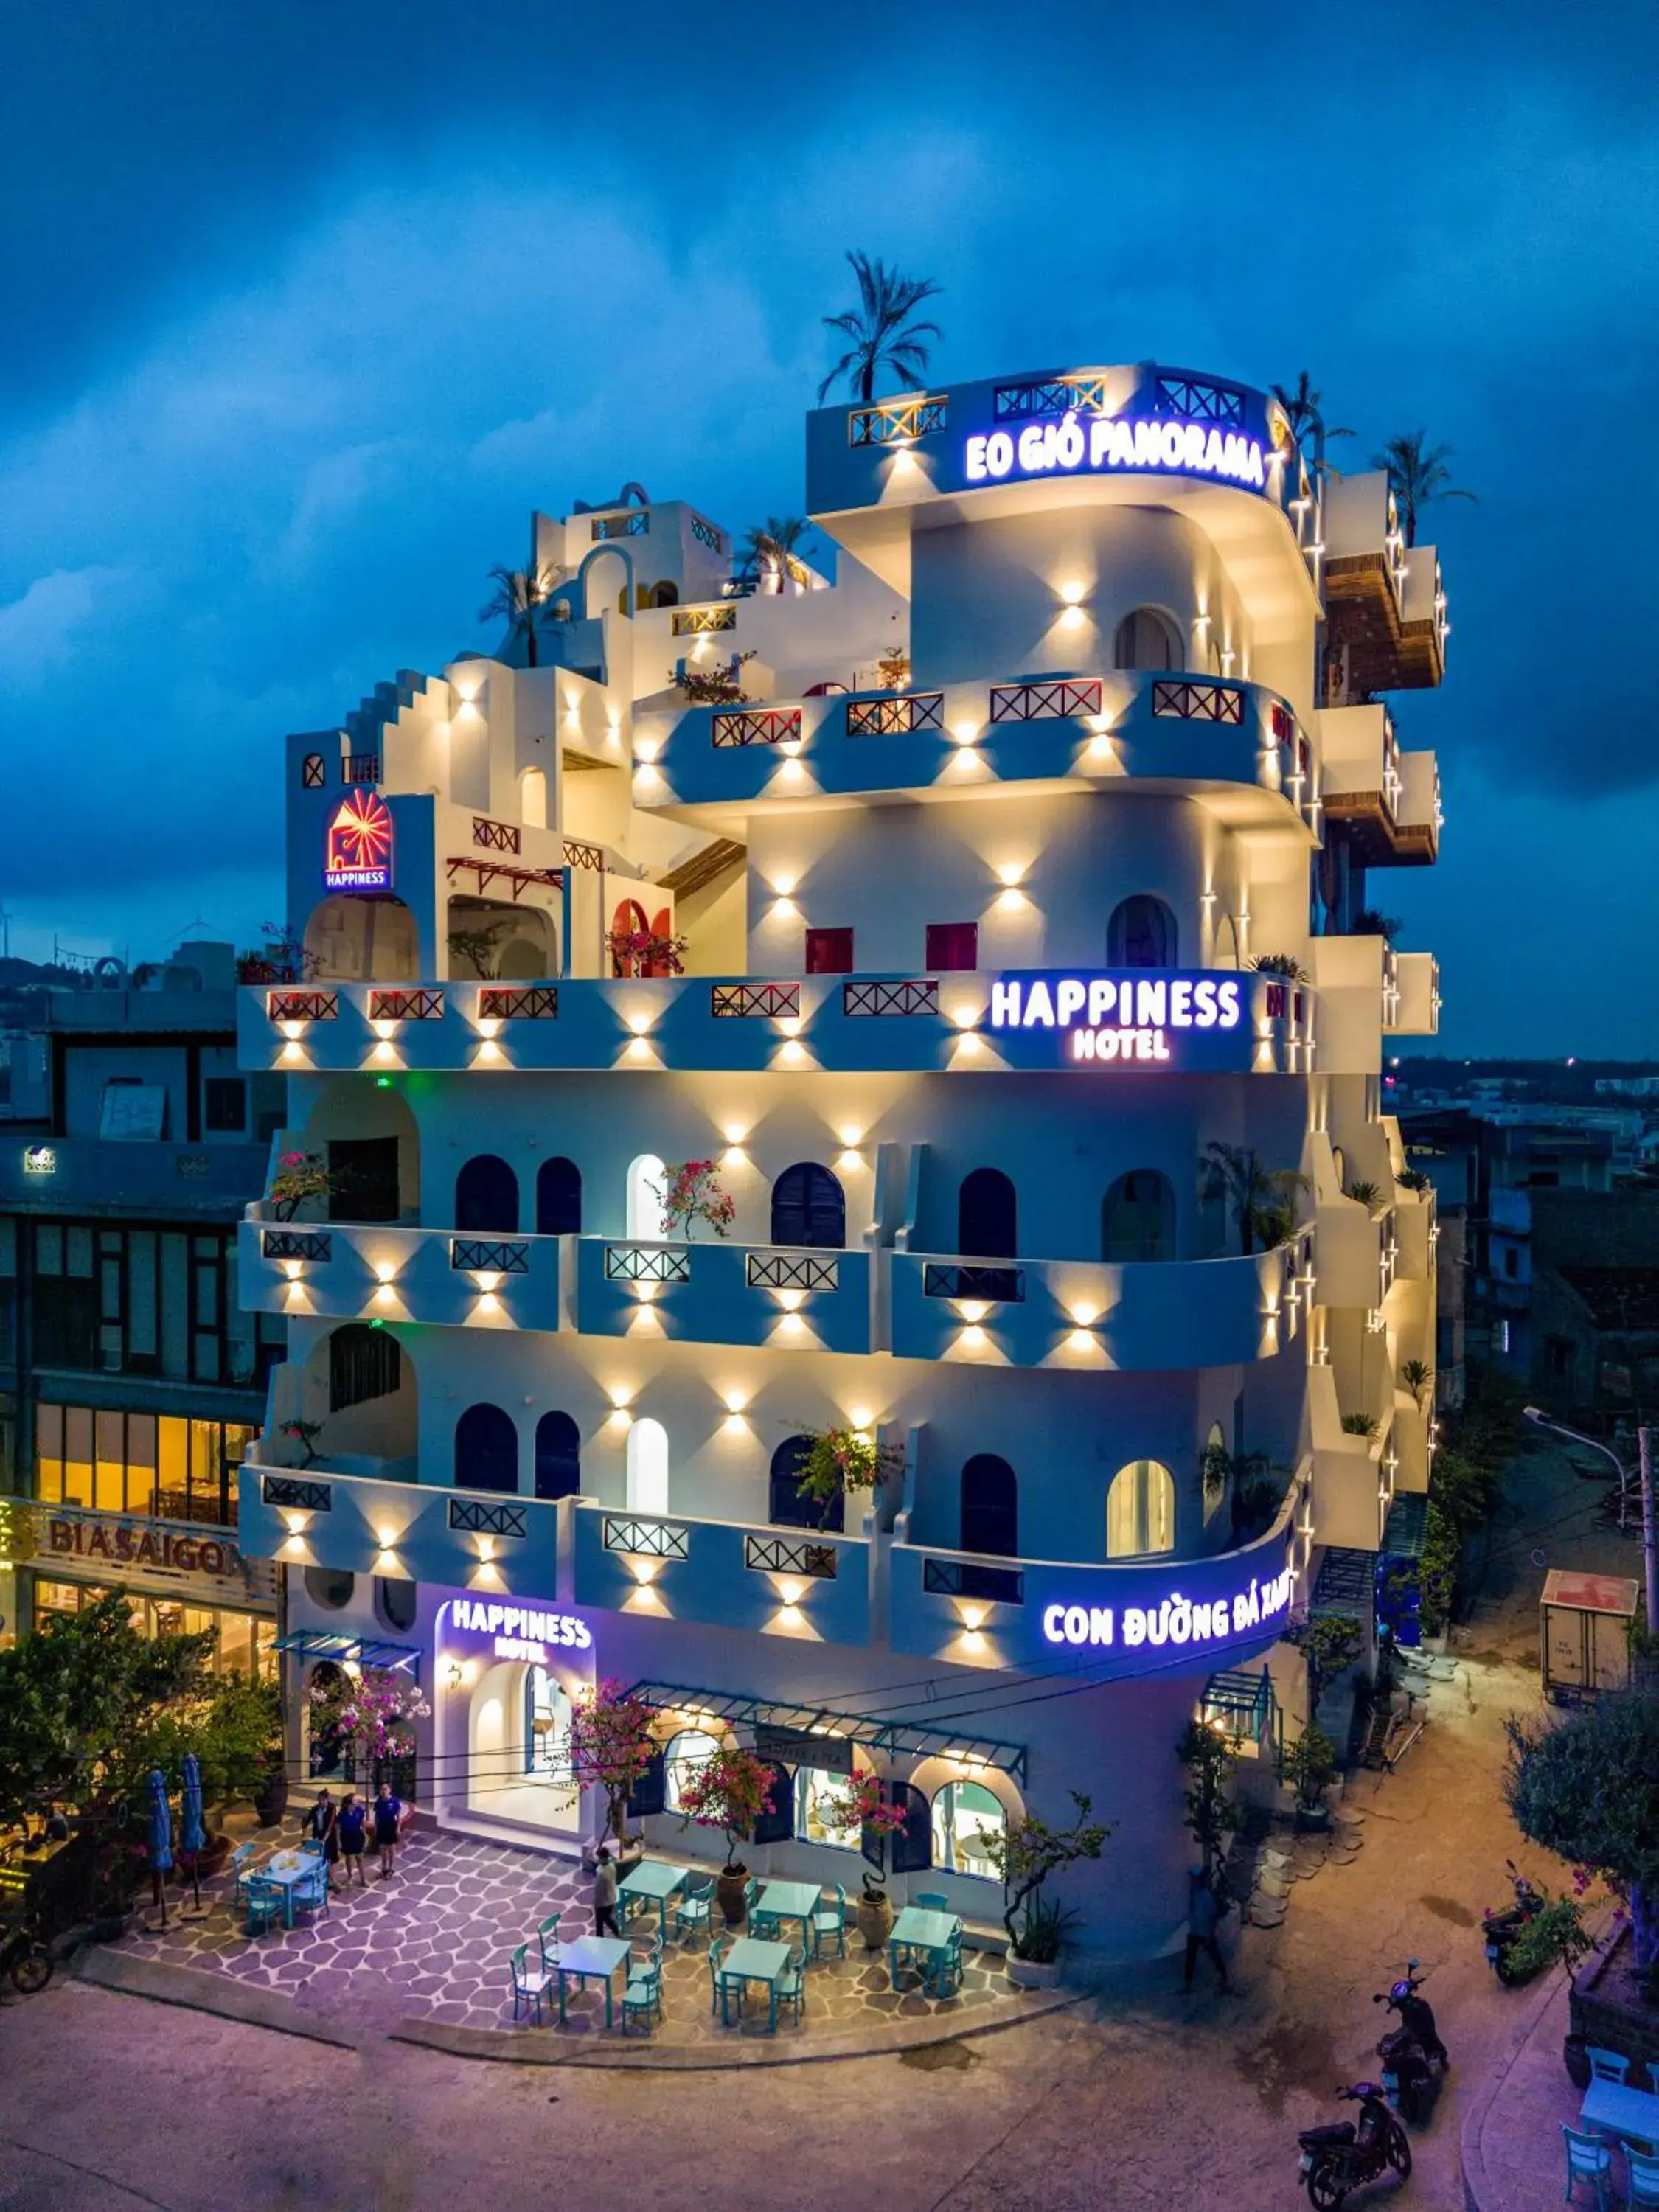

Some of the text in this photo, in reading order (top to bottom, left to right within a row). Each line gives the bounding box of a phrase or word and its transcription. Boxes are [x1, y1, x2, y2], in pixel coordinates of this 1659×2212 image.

[967, 412, 1264, 486] EO GIÓ PANORAMA
[327, 872, 384, 886] HAPPINESS
[992, 981, 1239, 1027] HAPPINESS
[1074, 1029, 1169, 1060] HOTEL
[453, 1600, 591, 1648] HAPPINESS
[1044, 1605, 1113, 1645] CON
[1122, 1593, 1228, 1646] ĐƯỜNG
[1232, 1579, 1260, 1632] ĐÁ
